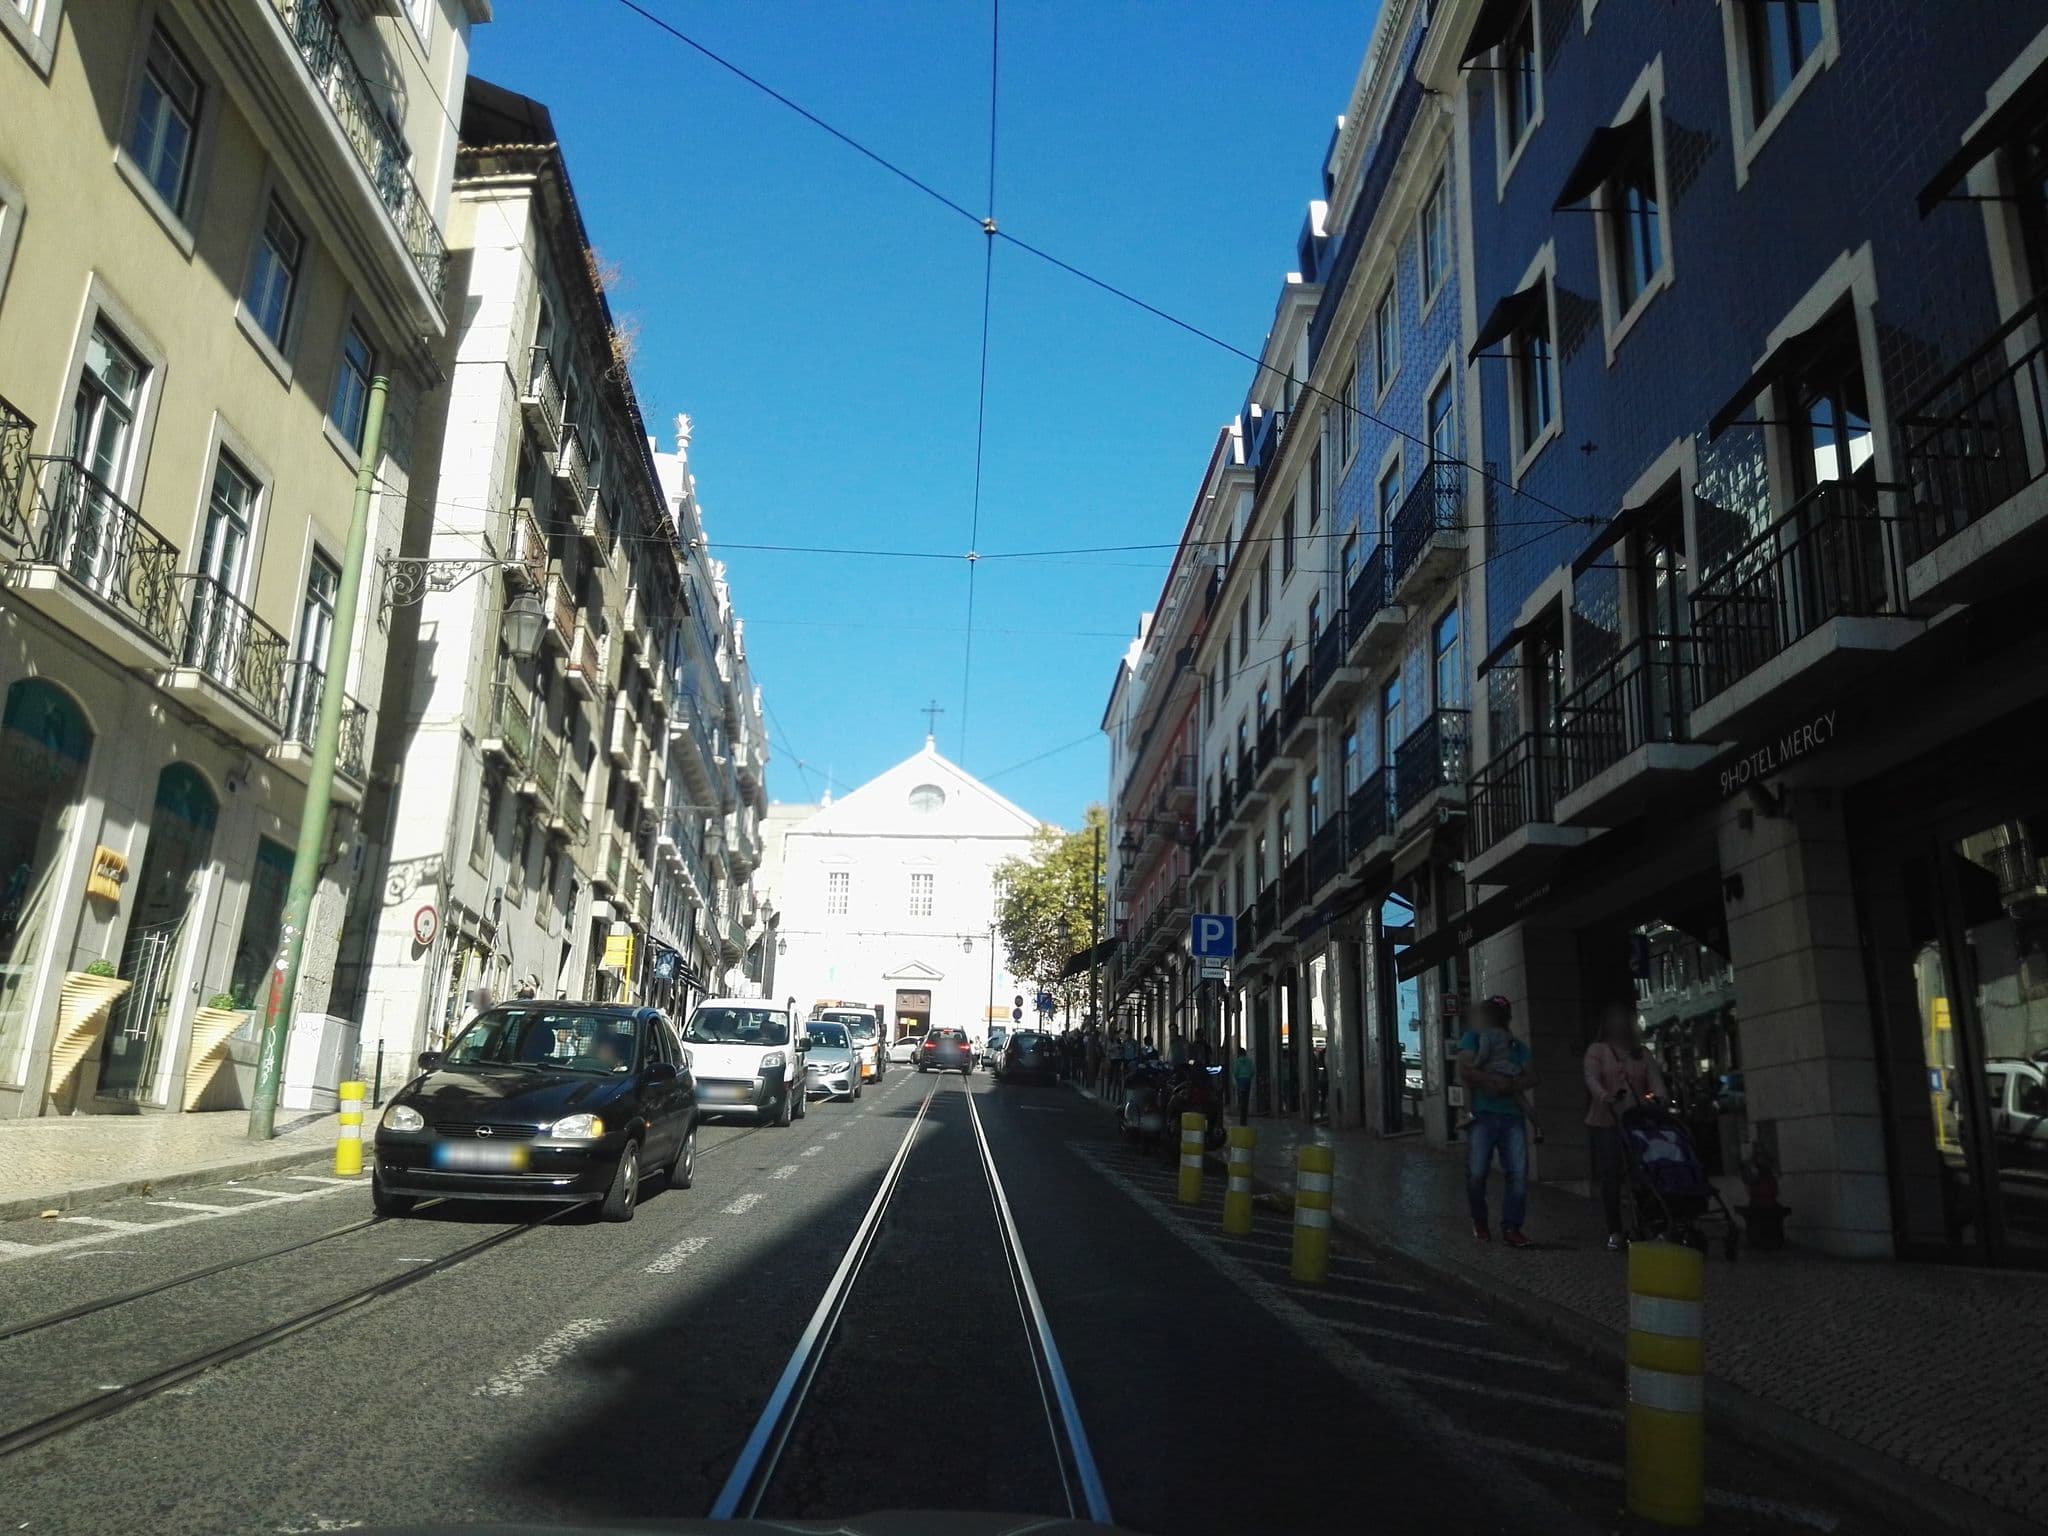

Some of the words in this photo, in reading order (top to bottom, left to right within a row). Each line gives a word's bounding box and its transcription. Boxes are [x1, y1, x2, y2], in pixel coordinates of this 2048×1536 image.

[1720, 746, 1776, 794] 9HOTEL
[1780, 709, 1836, 763] MERCY
[1201, 919, 1224, 952] P
